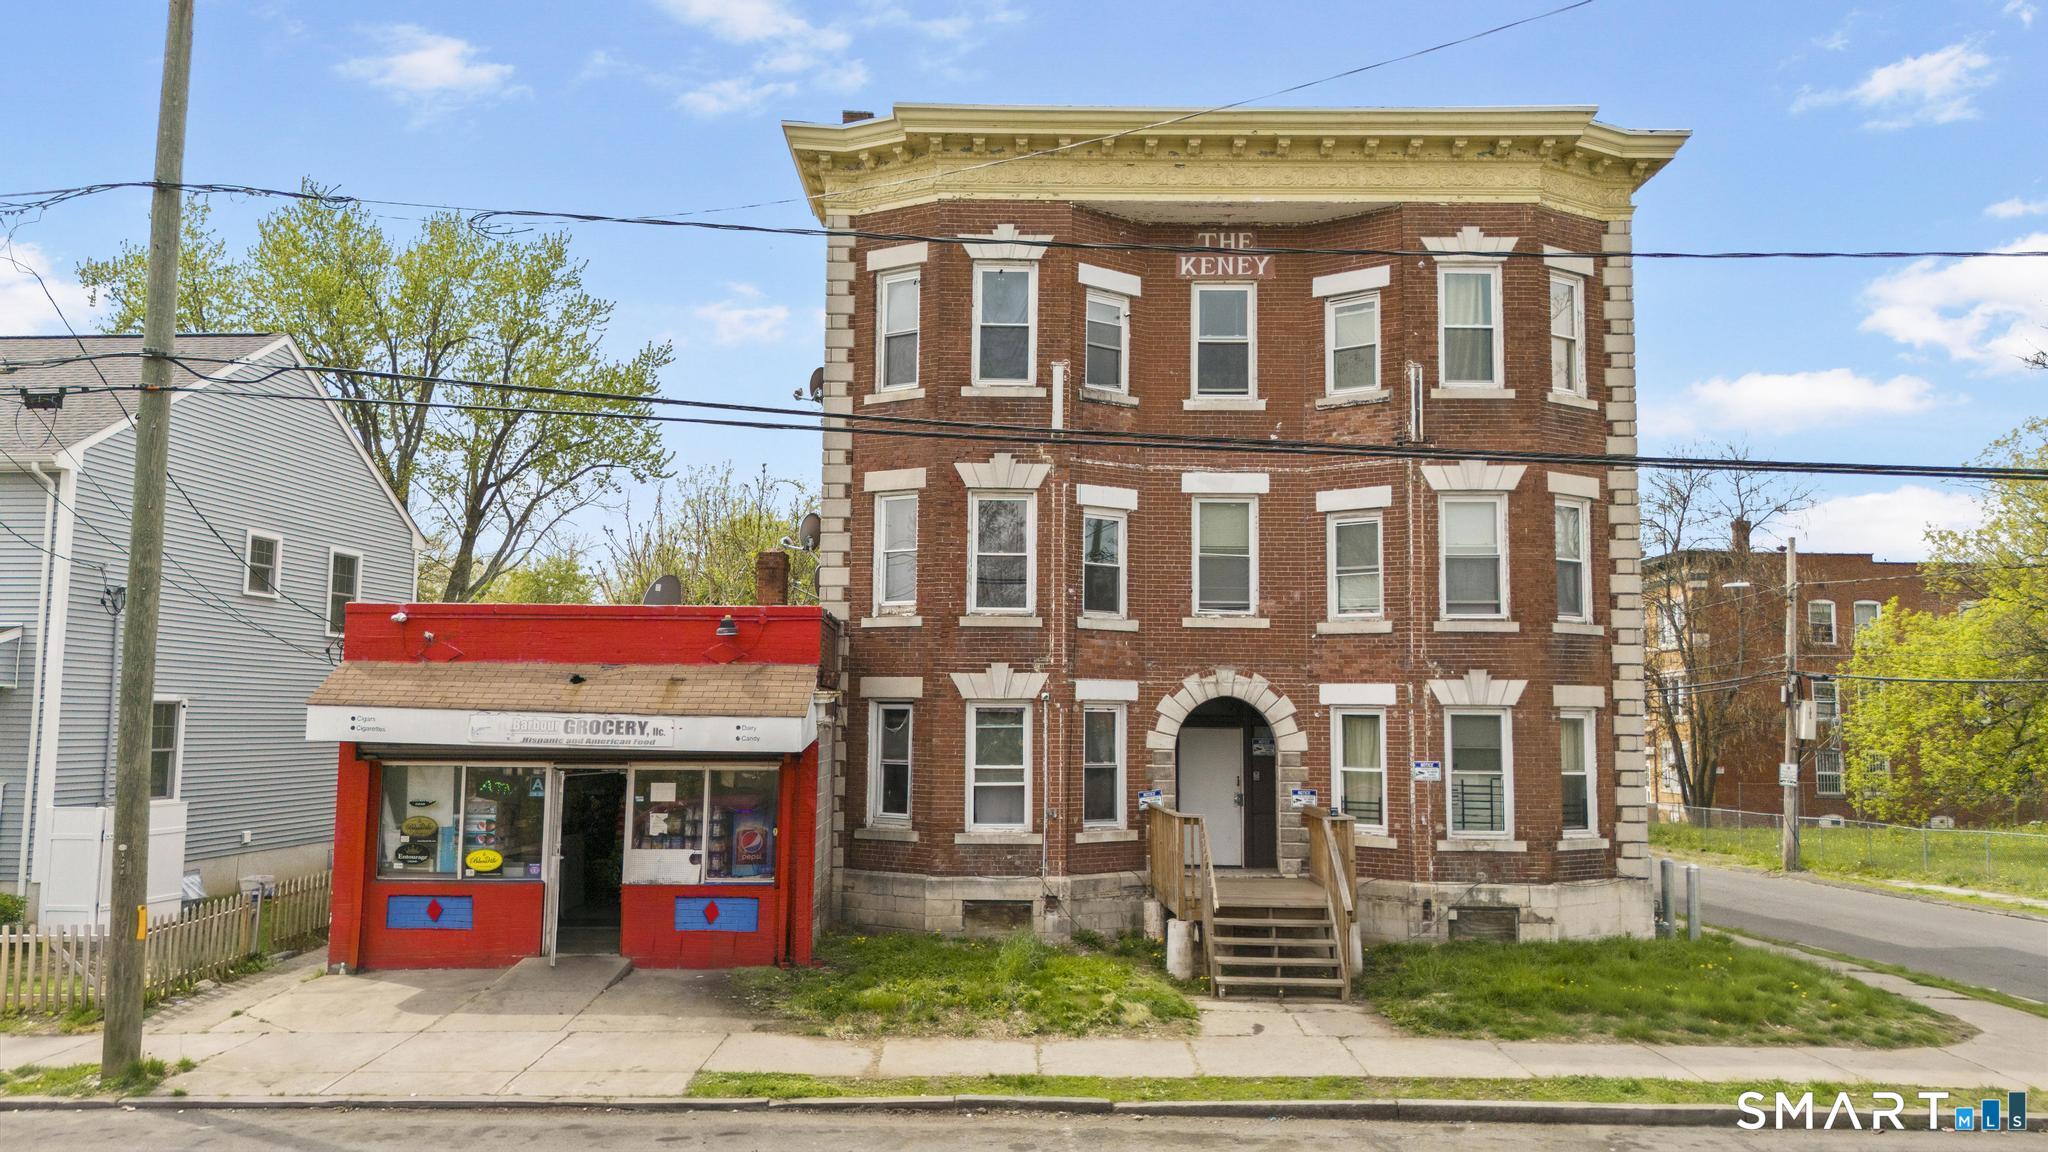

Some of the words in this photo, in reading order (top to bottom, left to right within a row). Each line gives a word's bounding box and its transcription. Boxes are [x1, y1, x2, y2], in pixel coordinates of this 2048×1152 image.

[1197, 232, 1254, 250] THE
[1180, 256, 1270, 275] KENEY
[563, 719, 650, 737] GROCERY,
[521, 736, 563, 744] Hispanic
[585, 737, 632, 745] American
[741, 735, 760, 743] Candy
